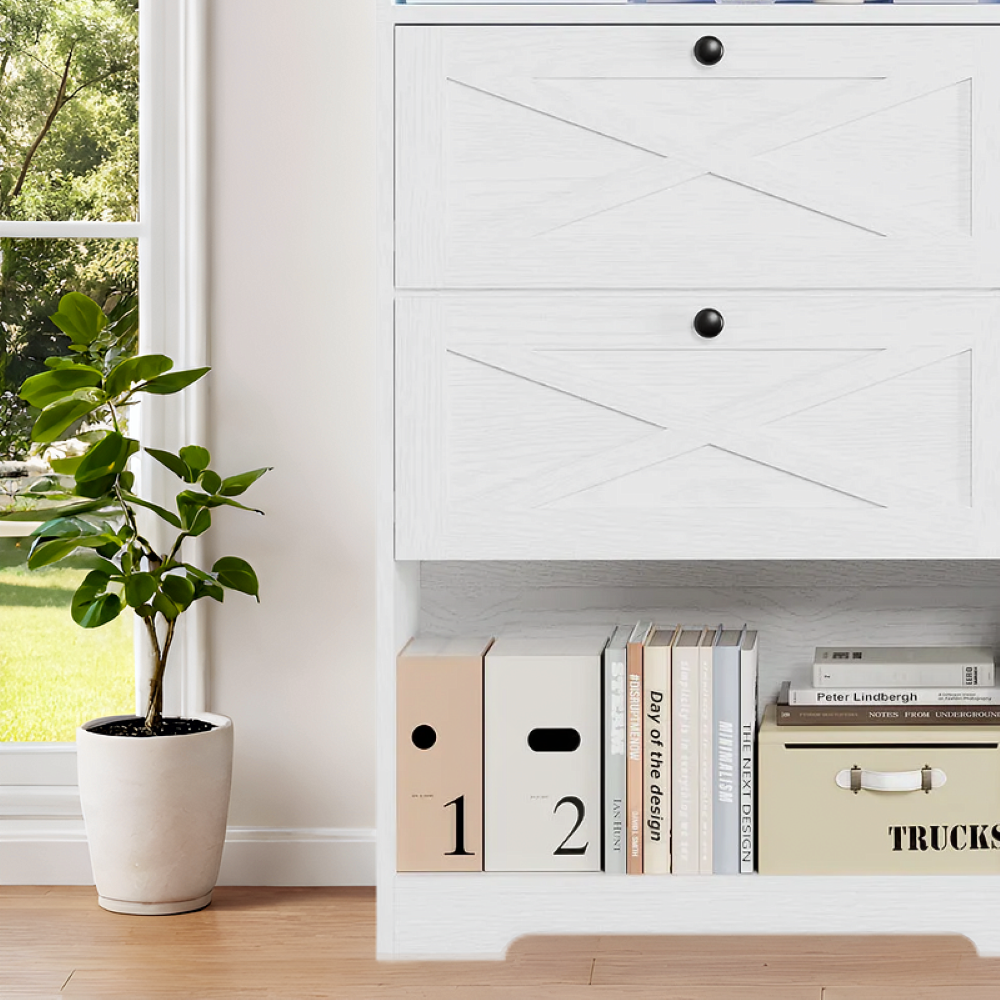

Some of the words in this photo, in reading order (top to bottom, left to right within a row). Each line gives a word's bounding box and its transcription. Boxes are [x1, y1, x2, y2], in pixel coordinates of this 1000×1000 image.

[630, 674, 640, 760] #DISRUPTMENOW
[648, 690, 664, 724] Day
[817, 692, 850, 702] Peter
[853, 692, 918, 704] Lindbergh
[650, 728, 664, 747] of
[742, 721, 752, 753] THE
[650, 750, 664, 779] the
[718, 720, 733, 803] MINIMALISM
[742, 756, 752, 800] NEXT
[443, 794, 476, 856] 1
[553, 795, 590, 856] 2
[612, 798, 621, 820] IAN
[648, 784, 664, 842] design
[612, 822, 621, 853] HUNT
[742, 804, 752, 863] DESIGN
